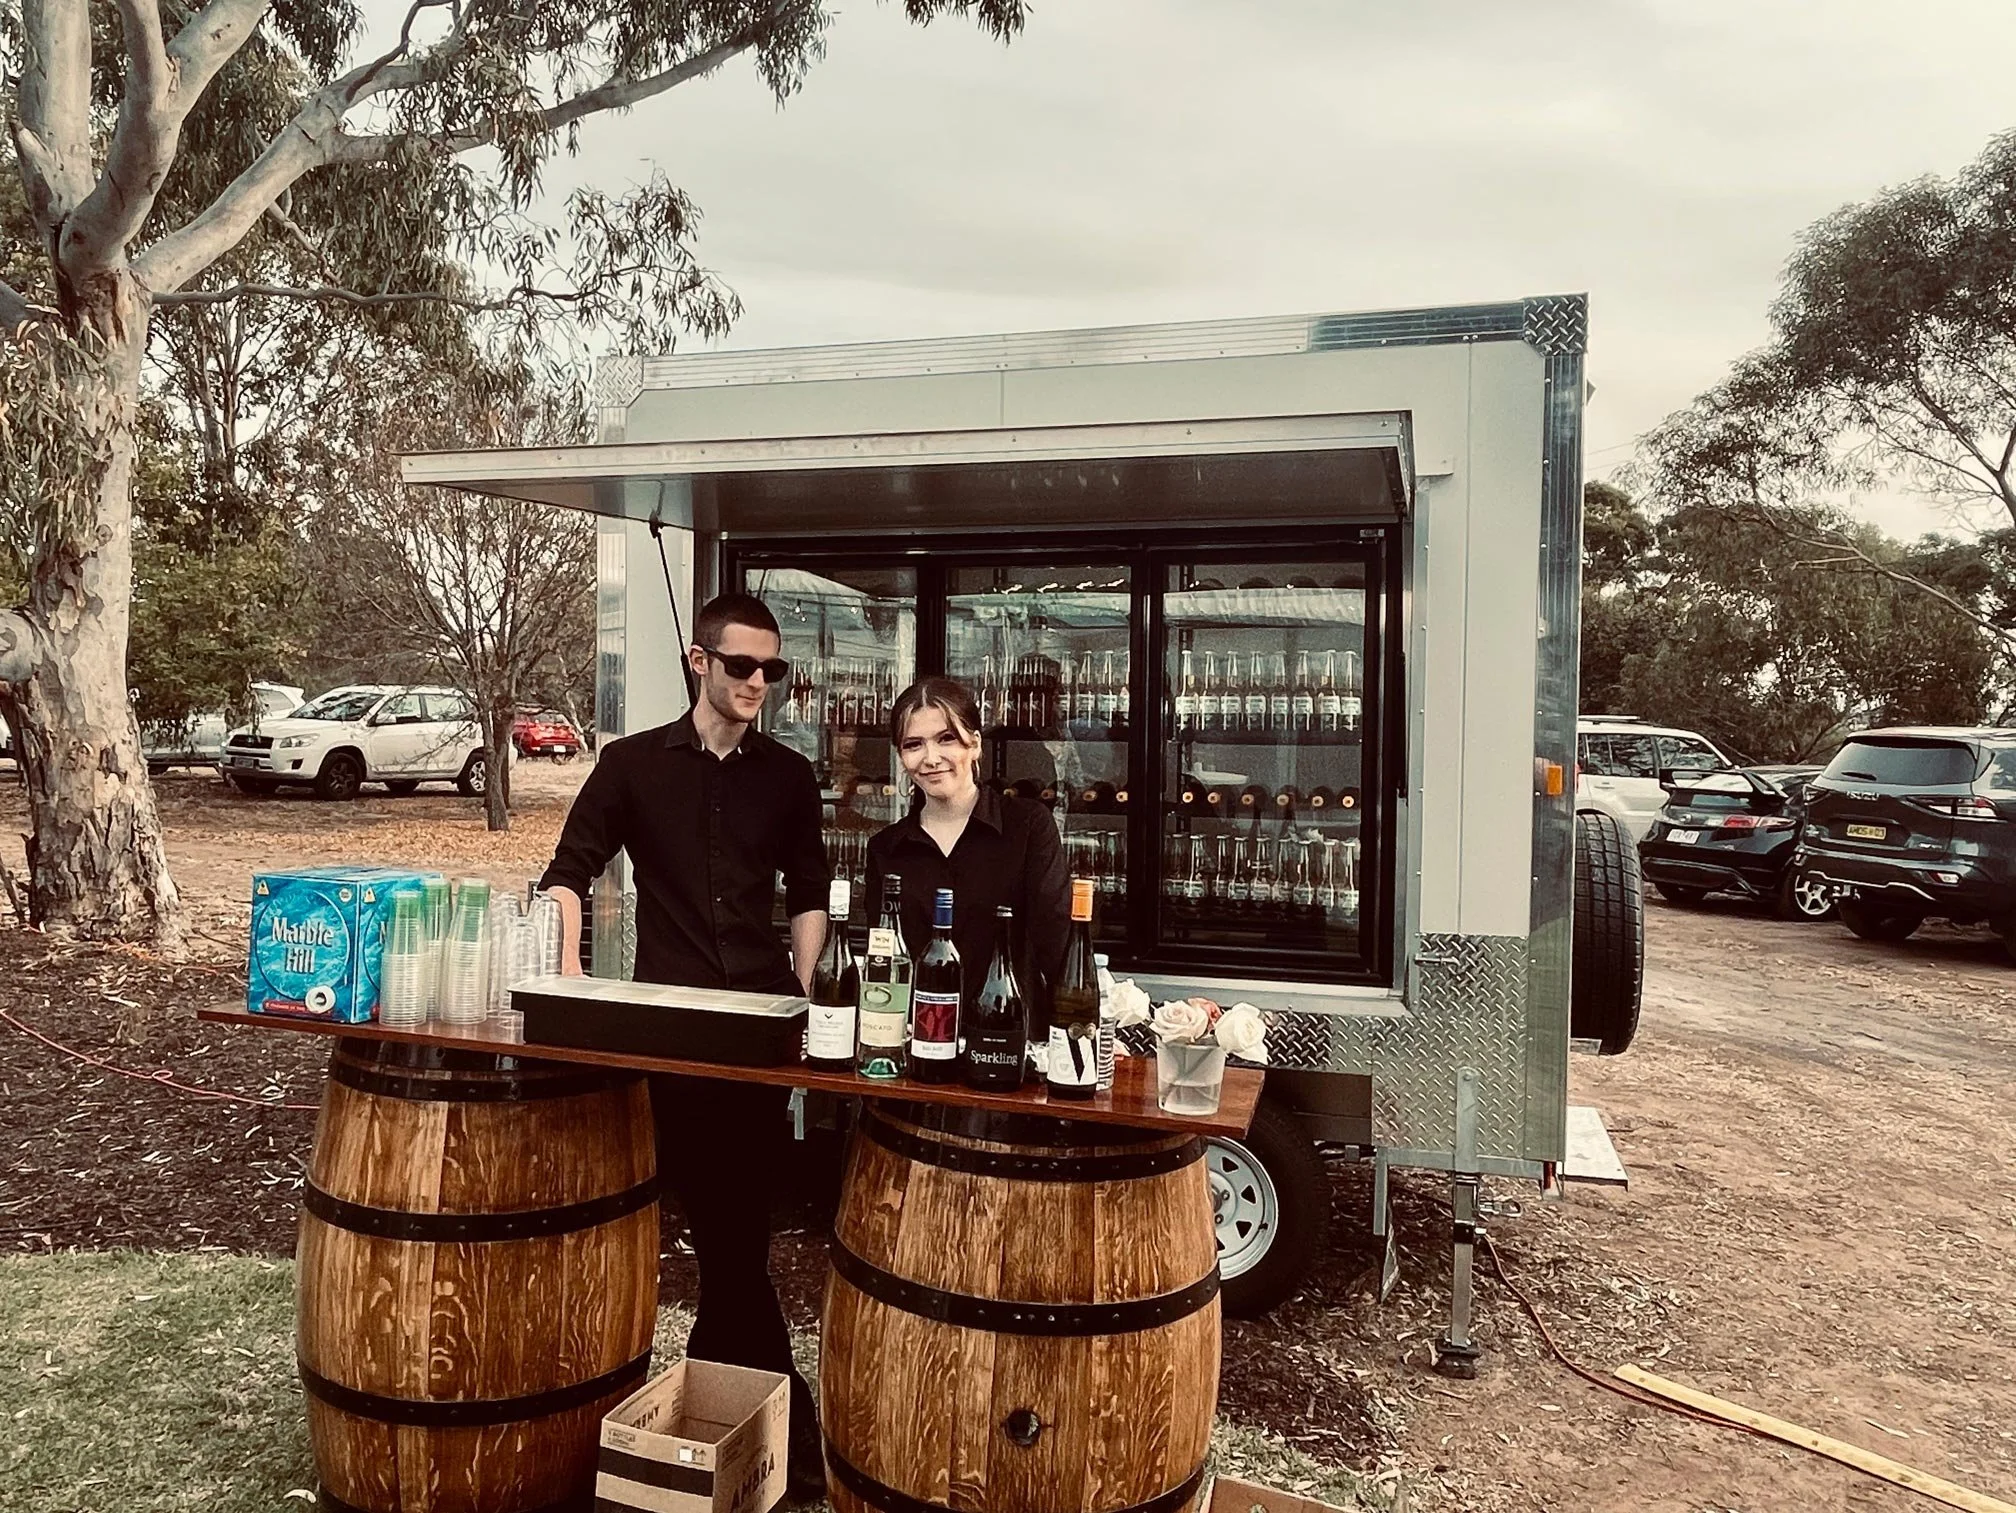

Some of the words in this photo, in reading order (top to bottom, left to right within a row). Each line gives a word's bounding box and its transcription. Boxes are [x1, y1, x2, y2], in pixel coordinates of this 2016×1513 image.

[272, 916, 334, 947] Marble
[285, 948, 315, 974] Hill
[970, 1049, 1018, 1066] Sparkling
